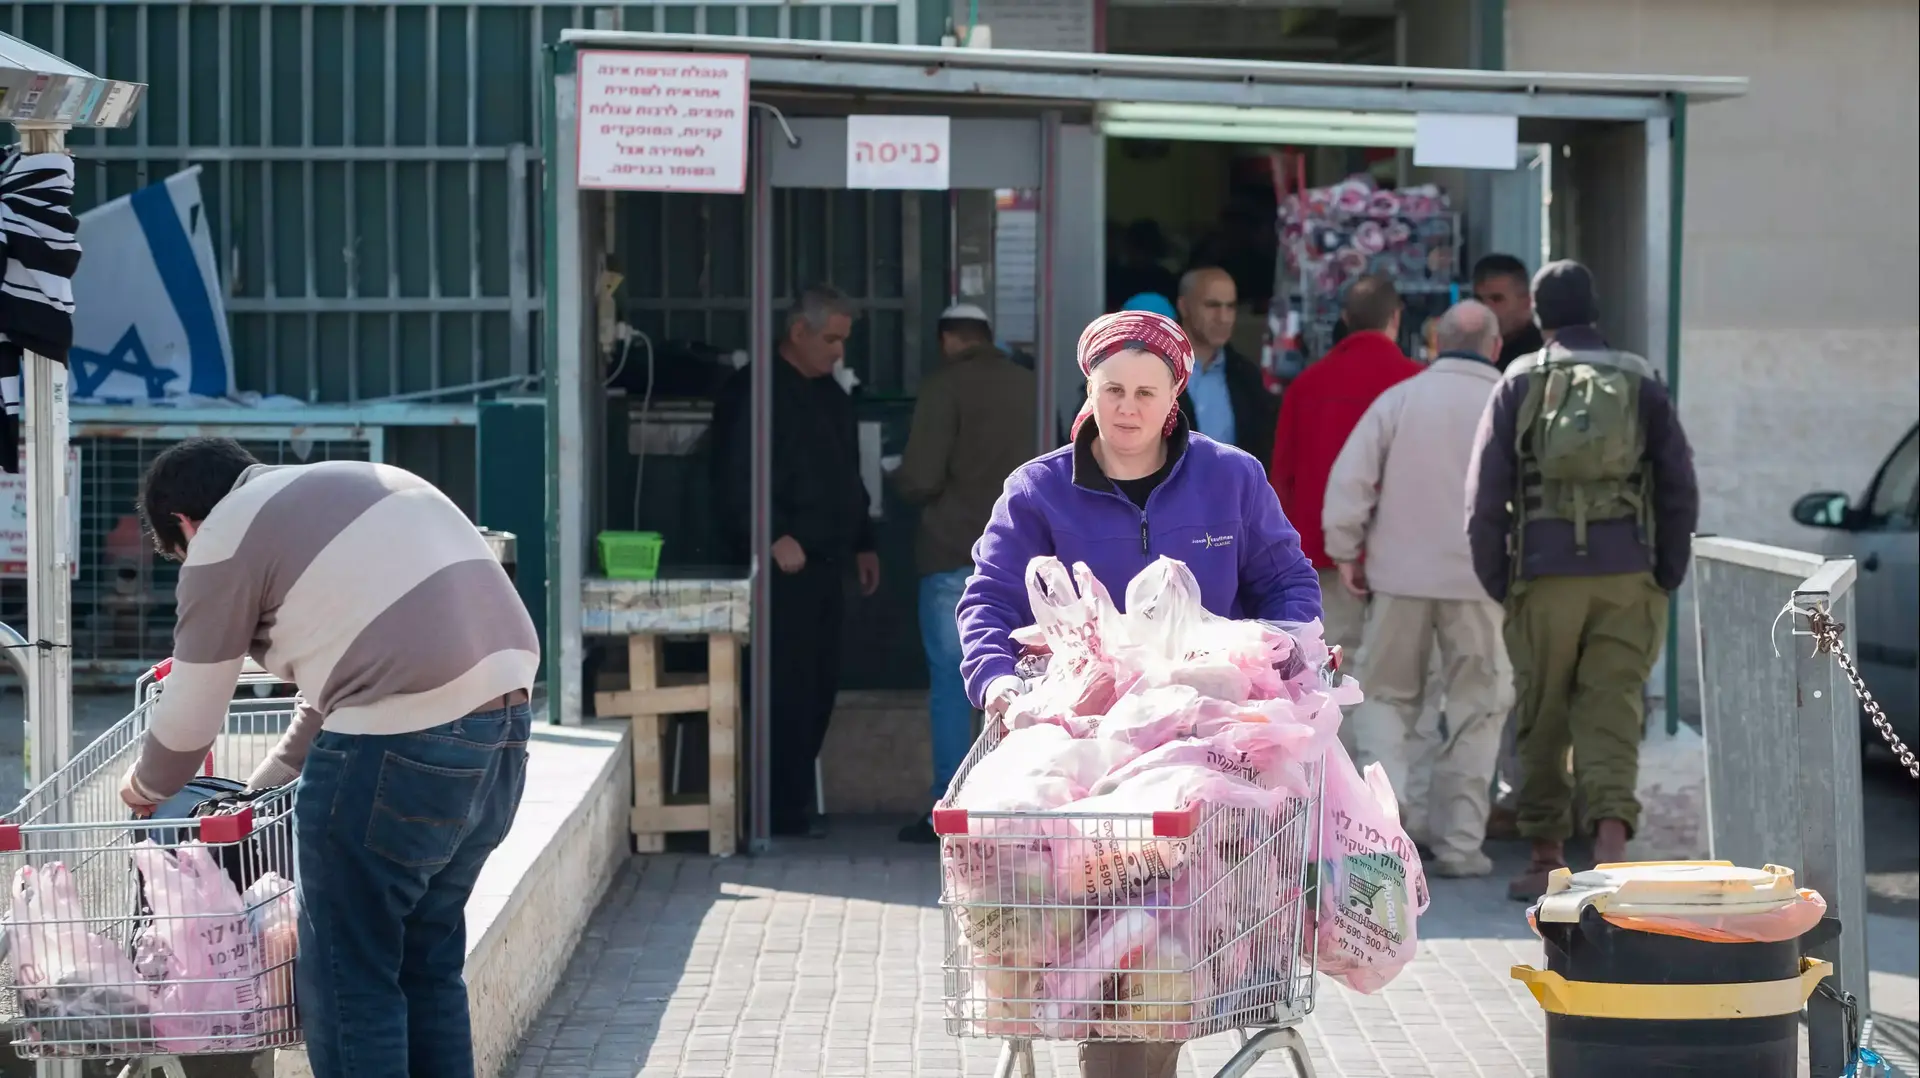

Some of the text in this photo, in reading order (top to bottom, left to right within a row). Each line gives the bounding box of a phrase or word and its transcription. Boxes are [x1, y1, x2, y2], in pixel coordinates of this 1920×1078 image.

[598, 65, 729, 79] הנהלת הרשת אינה
[604, 84, 721, 99] אחראית לשמירת
[589, 102, 736, 119] חפצים, לרבות עגלות
[600, 124, 673, 138] המופקדים
[615, 141, 706, 158] לשמירה אצל
[855, 141, 940, 165] כניסה
[671, 165, 716, 177] השומר
[1331, 809, 1388, 851] רמי לוי
[1350, 946, 1365, 960] רמי
